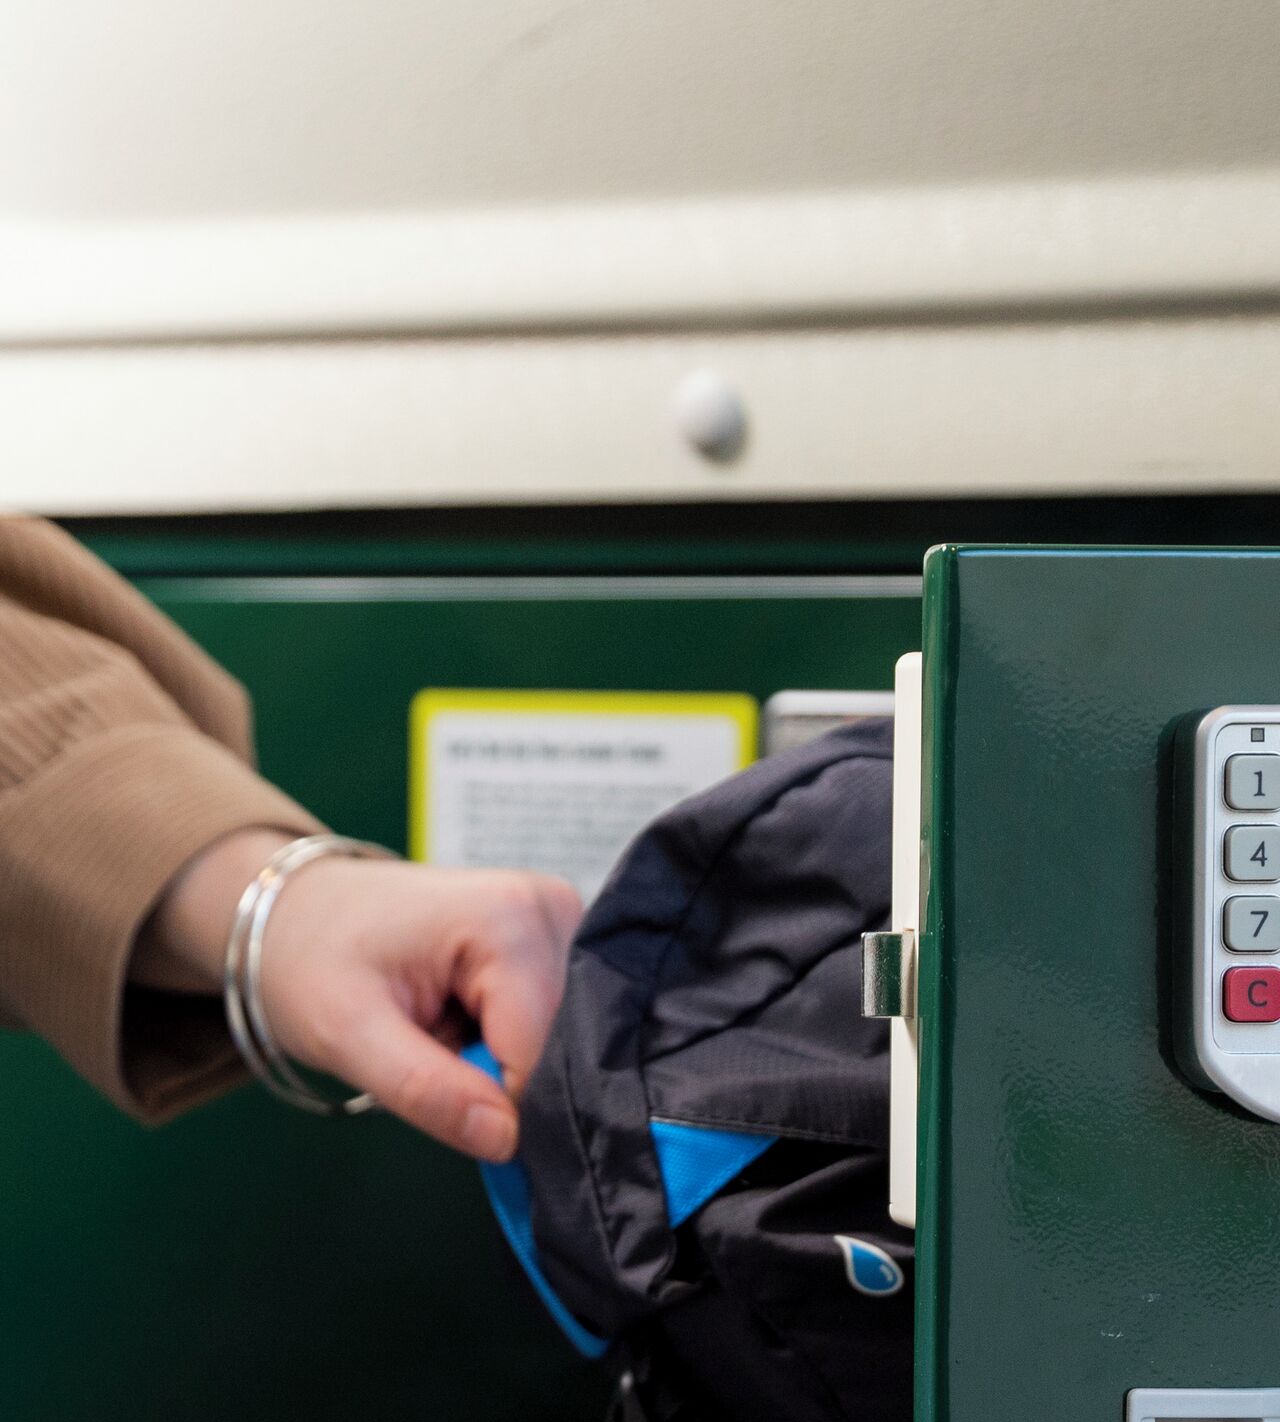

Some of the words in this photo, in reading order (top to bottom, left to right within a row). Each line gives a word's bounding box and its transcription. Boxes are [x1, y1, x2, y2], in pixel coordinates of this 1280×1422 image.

[1253, 770, 1266, 797] 1
[1249, 840, 1268, 867] 4
[1250, 910, 1269, 938] 7
[1247, 980, 1268, 1008] C
